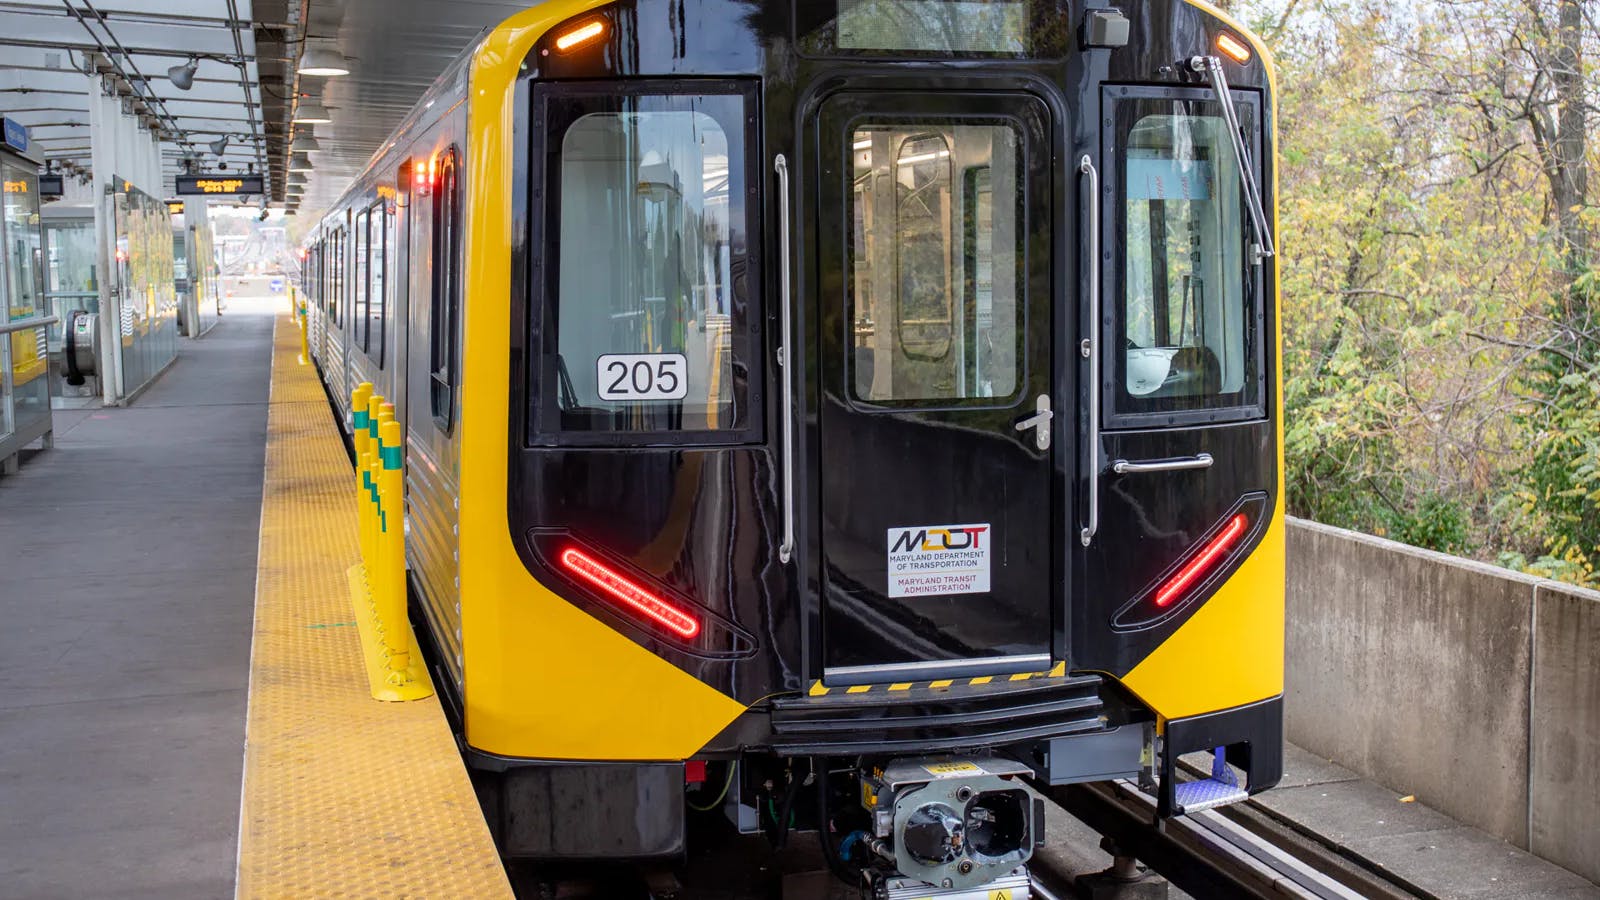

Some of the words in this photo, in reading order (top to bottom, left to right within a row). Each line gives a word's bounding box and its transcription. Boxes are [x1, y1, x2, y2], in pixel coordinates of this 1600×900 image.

[607, 361, 678, 394] 205
[891, 527, 988, 552] MDOT
[890, 553, 931, 563] MARYLAND
[934, 551, 985, 560] DEPARTMENT
[910, 560, 978, 570] TRANSPORTATION
[898, 577, 942, 586] MARYLAND
[944, 574, 977, 583] TRANSIT
[904, 583, 971, 594] ADMINISTRATION
